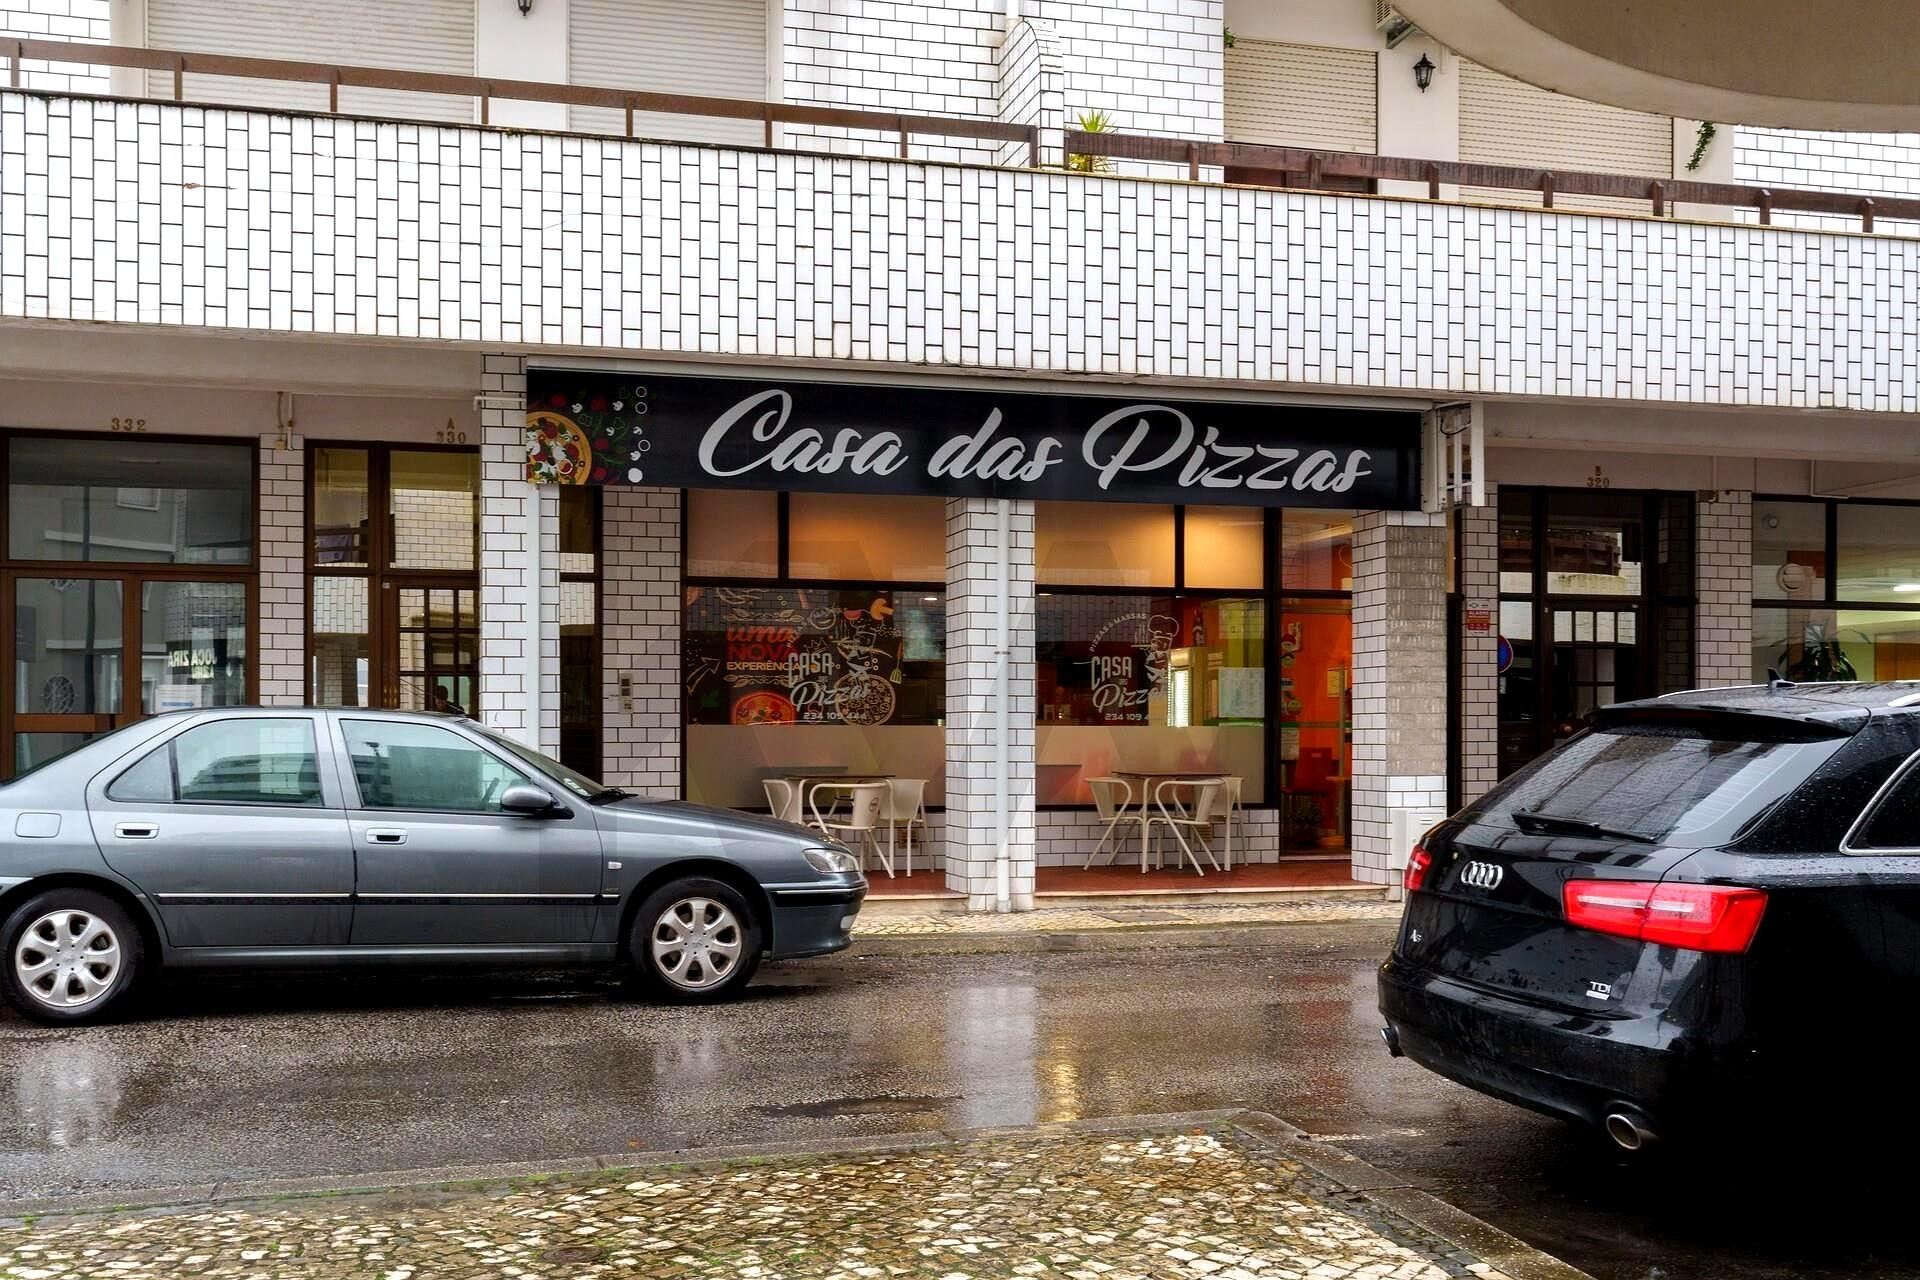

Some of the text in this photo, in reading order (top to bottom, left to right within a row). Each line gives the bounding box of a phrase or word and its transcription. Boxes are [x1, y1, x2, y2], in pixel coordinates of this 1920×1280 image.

[111, 417, 146, 431] 332
[698, 389, 1372, 493] Casa das Pizzas
[726, 660, 800, 671] EXPERIÊNCA
[788, 652, 833, 689] CASA
[1091, 656, 1132, 690] CASA
[1590, 981, 1611, 993] TDI
